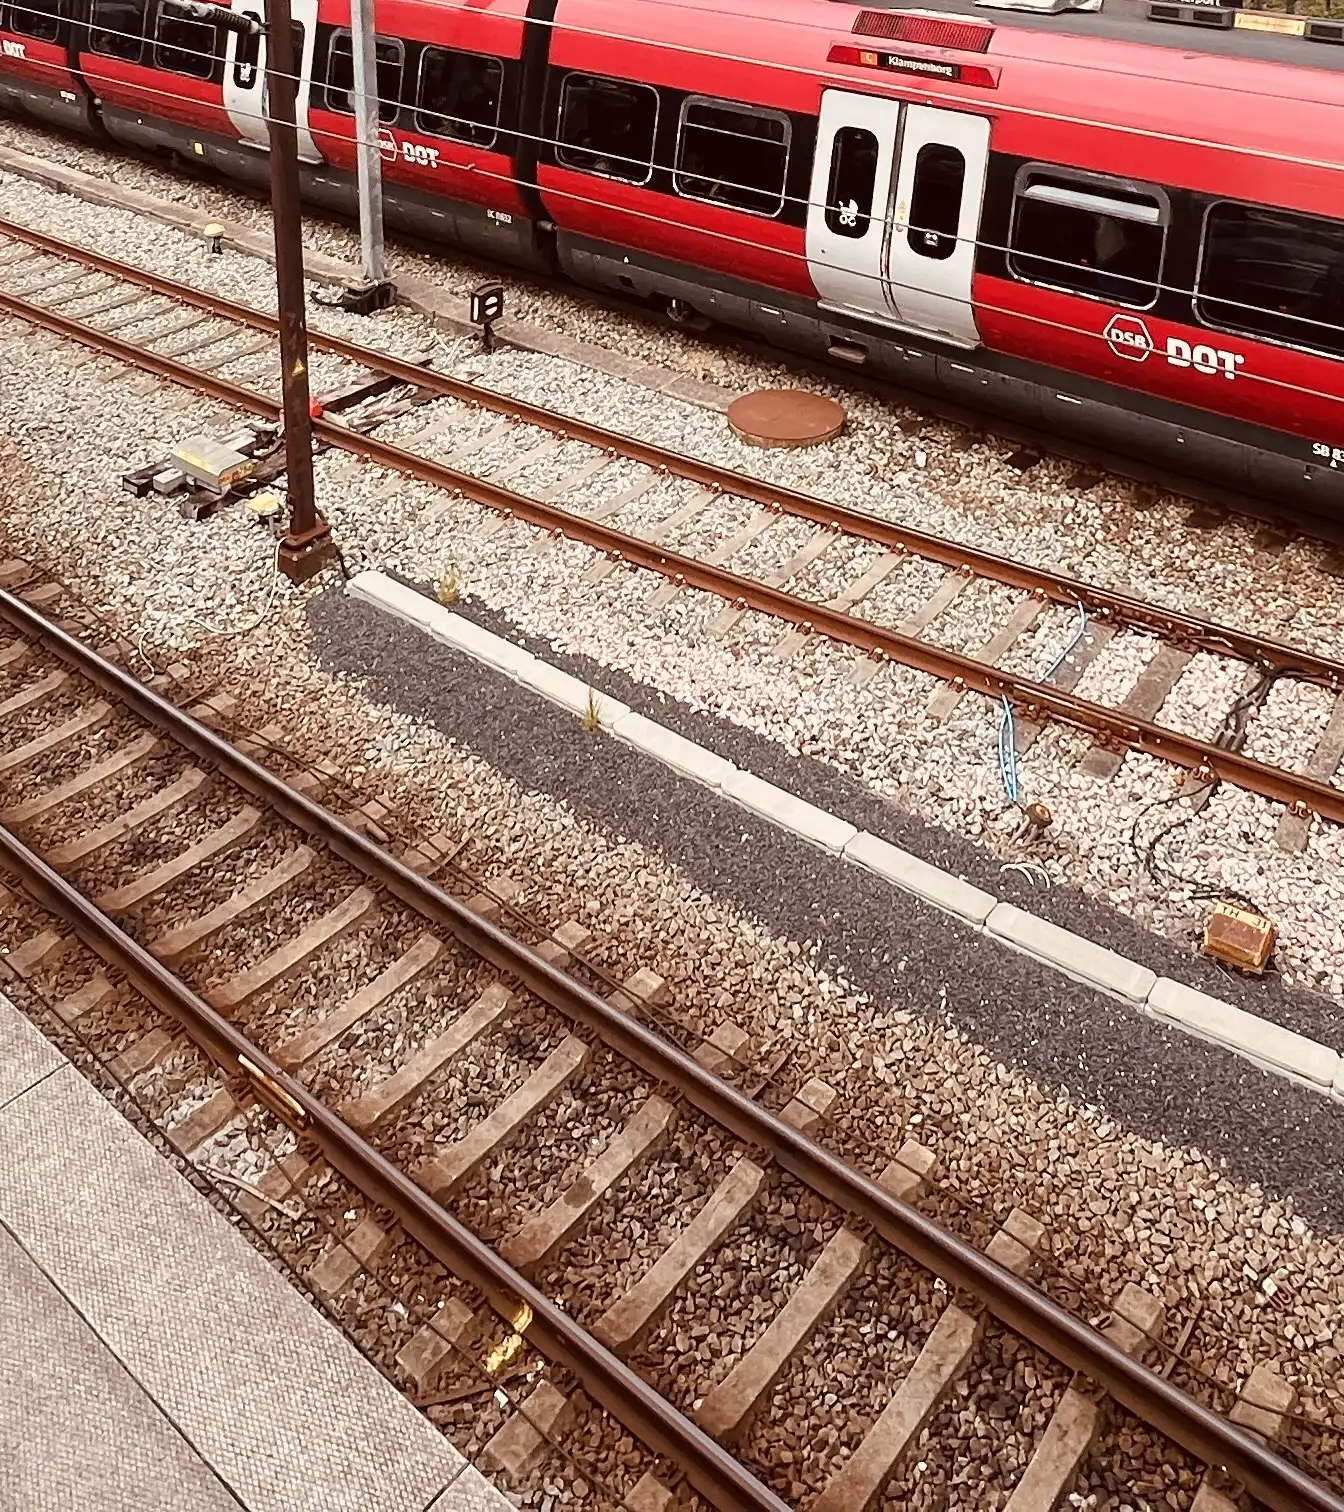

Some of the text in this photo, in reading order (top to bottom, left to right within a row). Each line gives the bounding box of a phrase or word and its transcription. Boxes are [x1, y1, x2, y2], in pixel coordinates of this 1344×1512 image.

[888, 55, 953, 77] Klampenborg
[402, 141, 440, 169] DOT
[1110, 328, 1148, 348] DSB
[1167, 336, 1245, 380] DOT
[1312, 442, 1330, 458] SB
